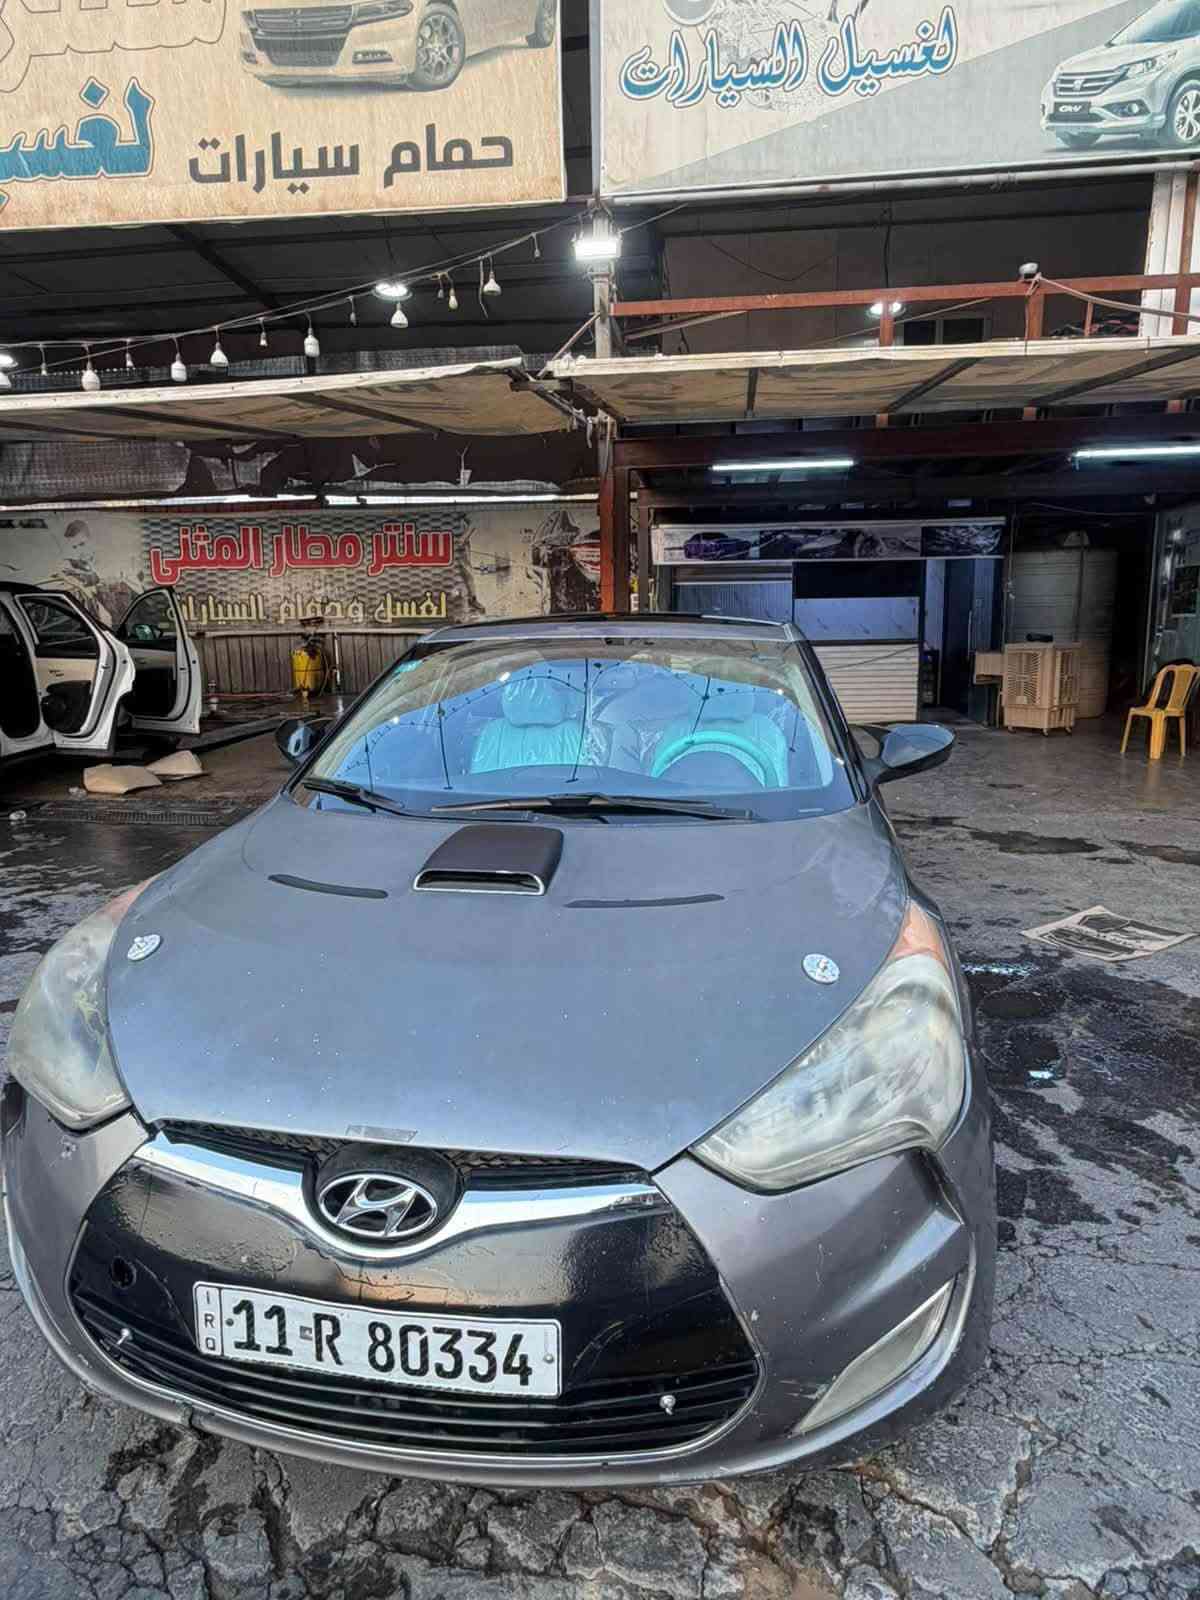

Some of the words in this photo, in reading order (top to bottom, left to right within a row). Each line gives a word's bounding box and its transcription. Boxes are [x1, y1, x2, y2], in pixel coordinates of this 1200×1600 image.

[620, 17, 808, 109] السيارات
[816, 5, 958, 97] لغسيل
[0, 76, 155, 190] لغس
[188, 132, 360, 194] سيارات
[384, 123, 514, 188] حمام
[150, 523, 263, 585] المثنى
[269, 523, 361, 577] مطار
[368, 523, 453, 576] سنتر
[203, 1290, 217, 1351] IRQ
[231, 1299, 293, 1357] 11
[367, 1320, 533, 1387] 80334
